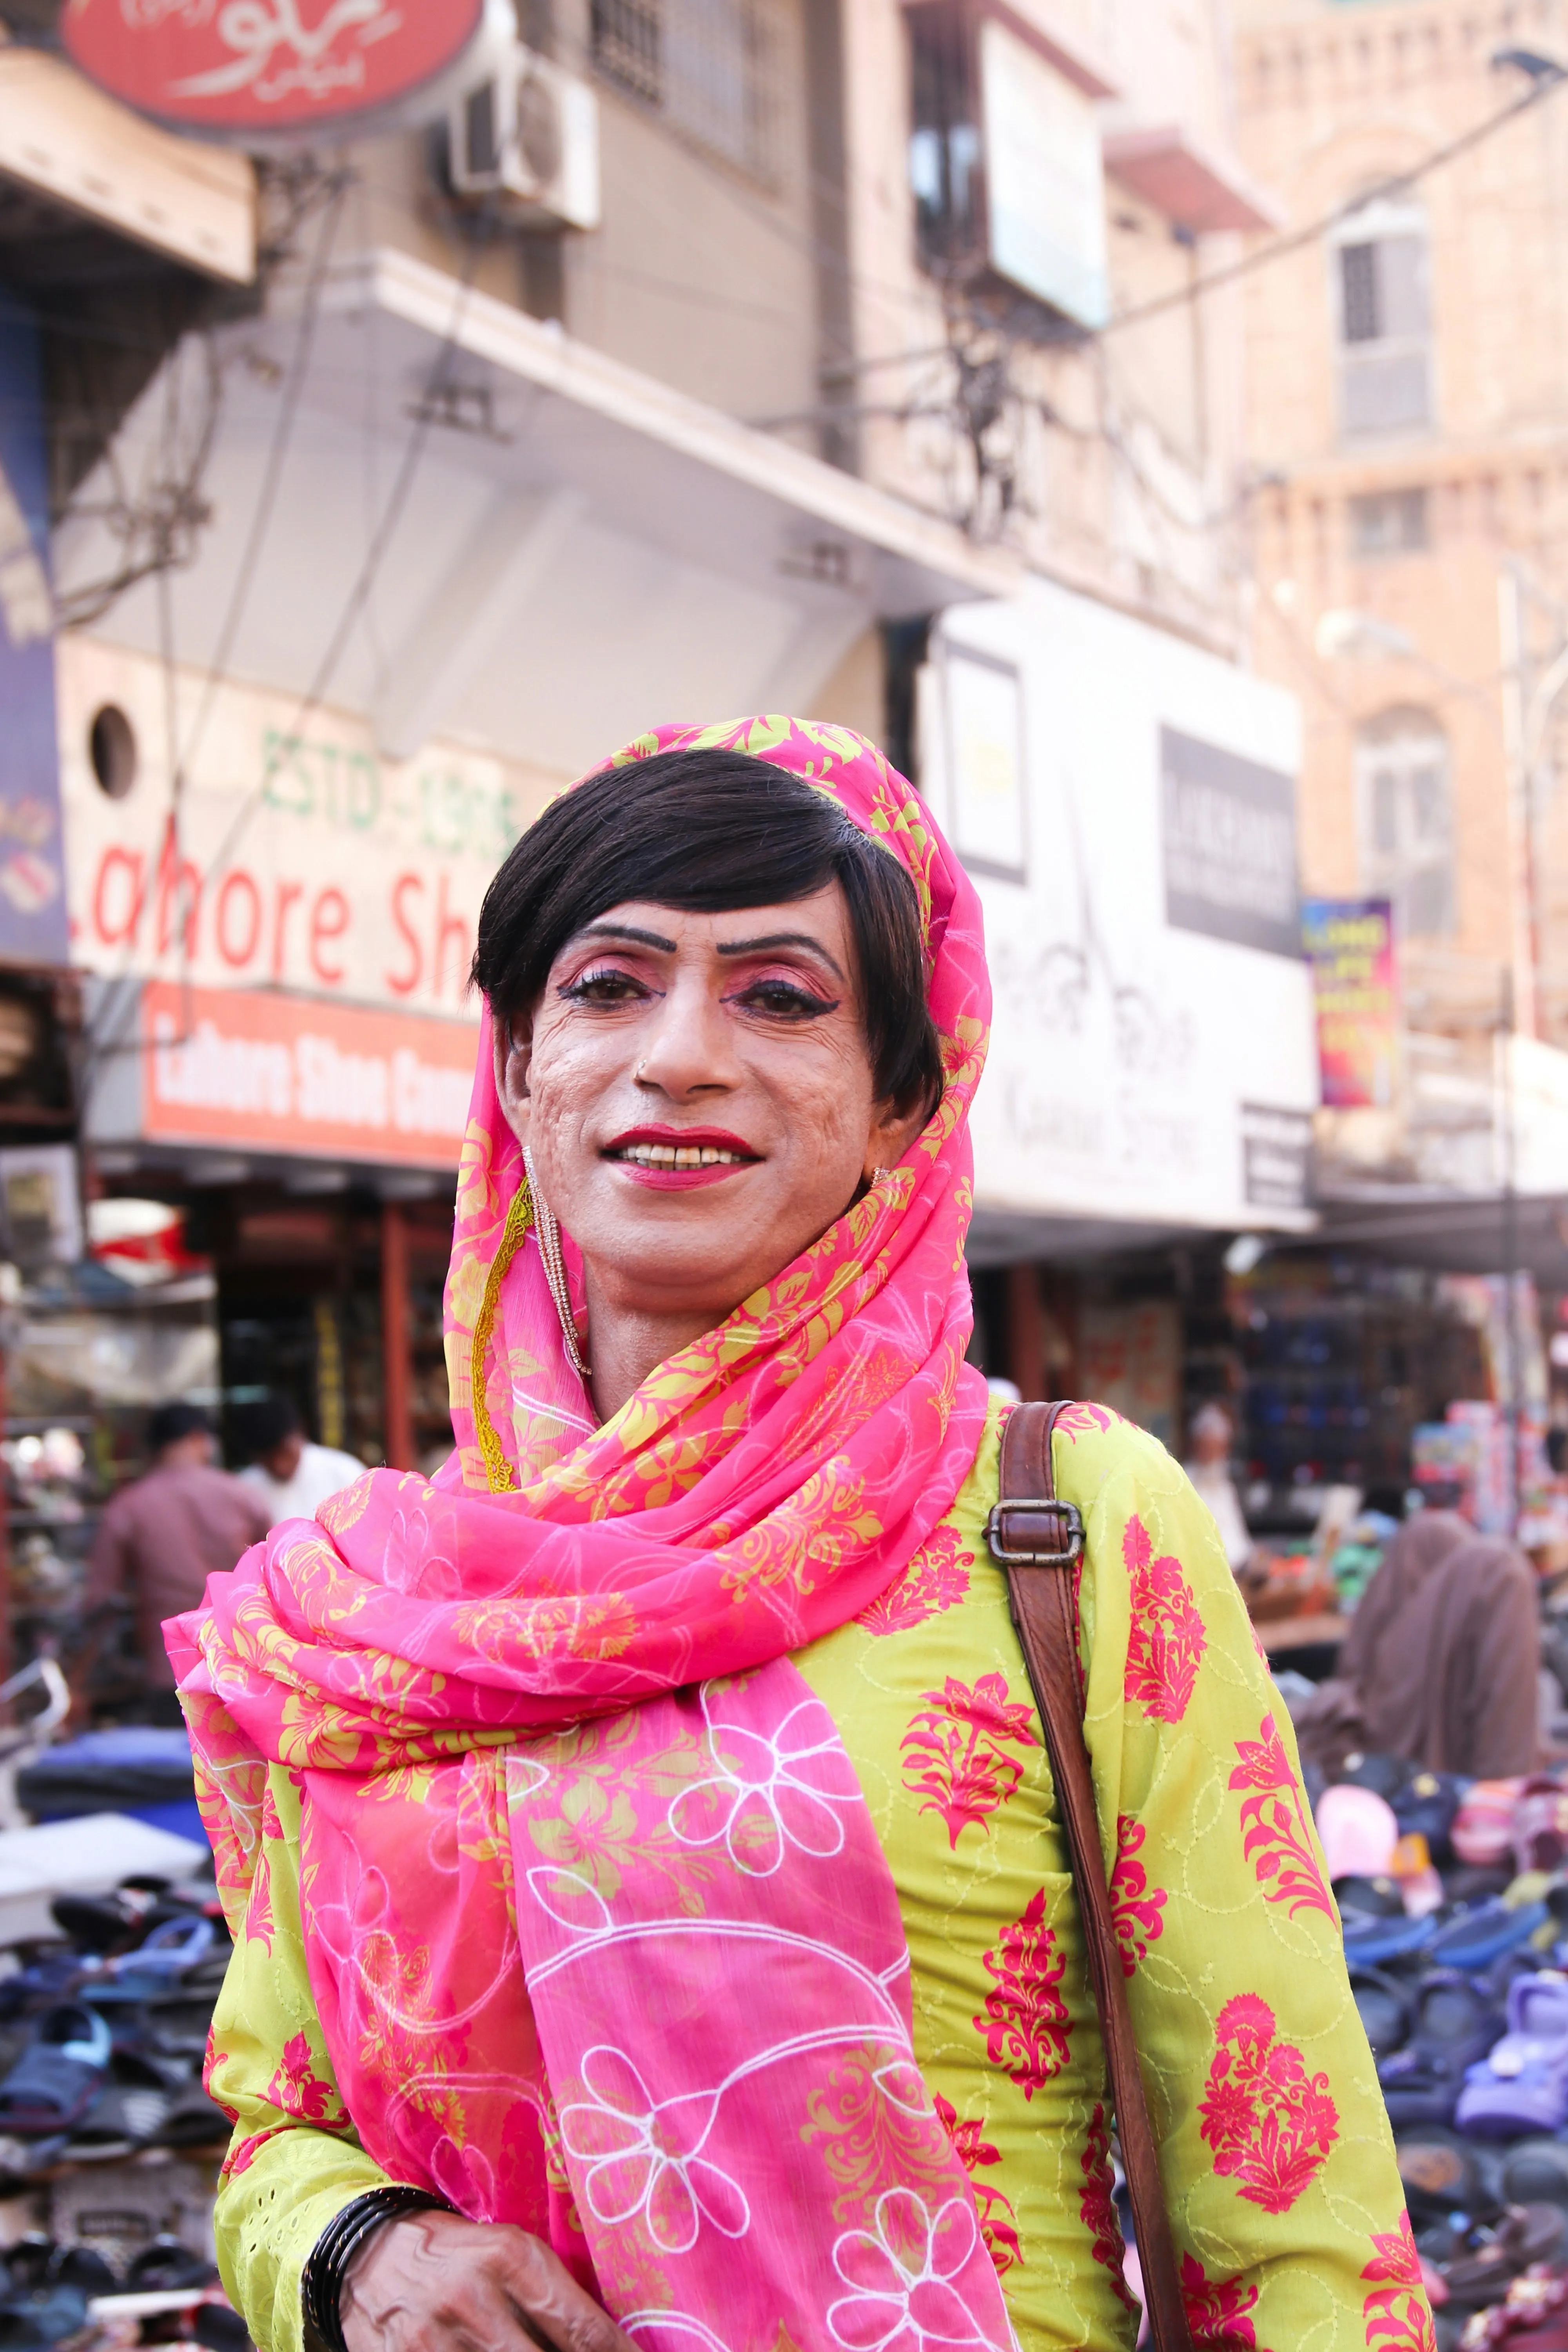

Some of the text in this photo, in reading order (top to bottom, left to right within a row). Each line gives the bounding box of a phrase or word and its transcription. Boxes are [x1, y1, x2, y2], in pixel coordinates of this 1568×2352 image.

[70, 812, 476, 1007] ahore Sh
[154, 1013, 292, 1117] Lahore
[295, 1032, 390, 1128] Shoe
